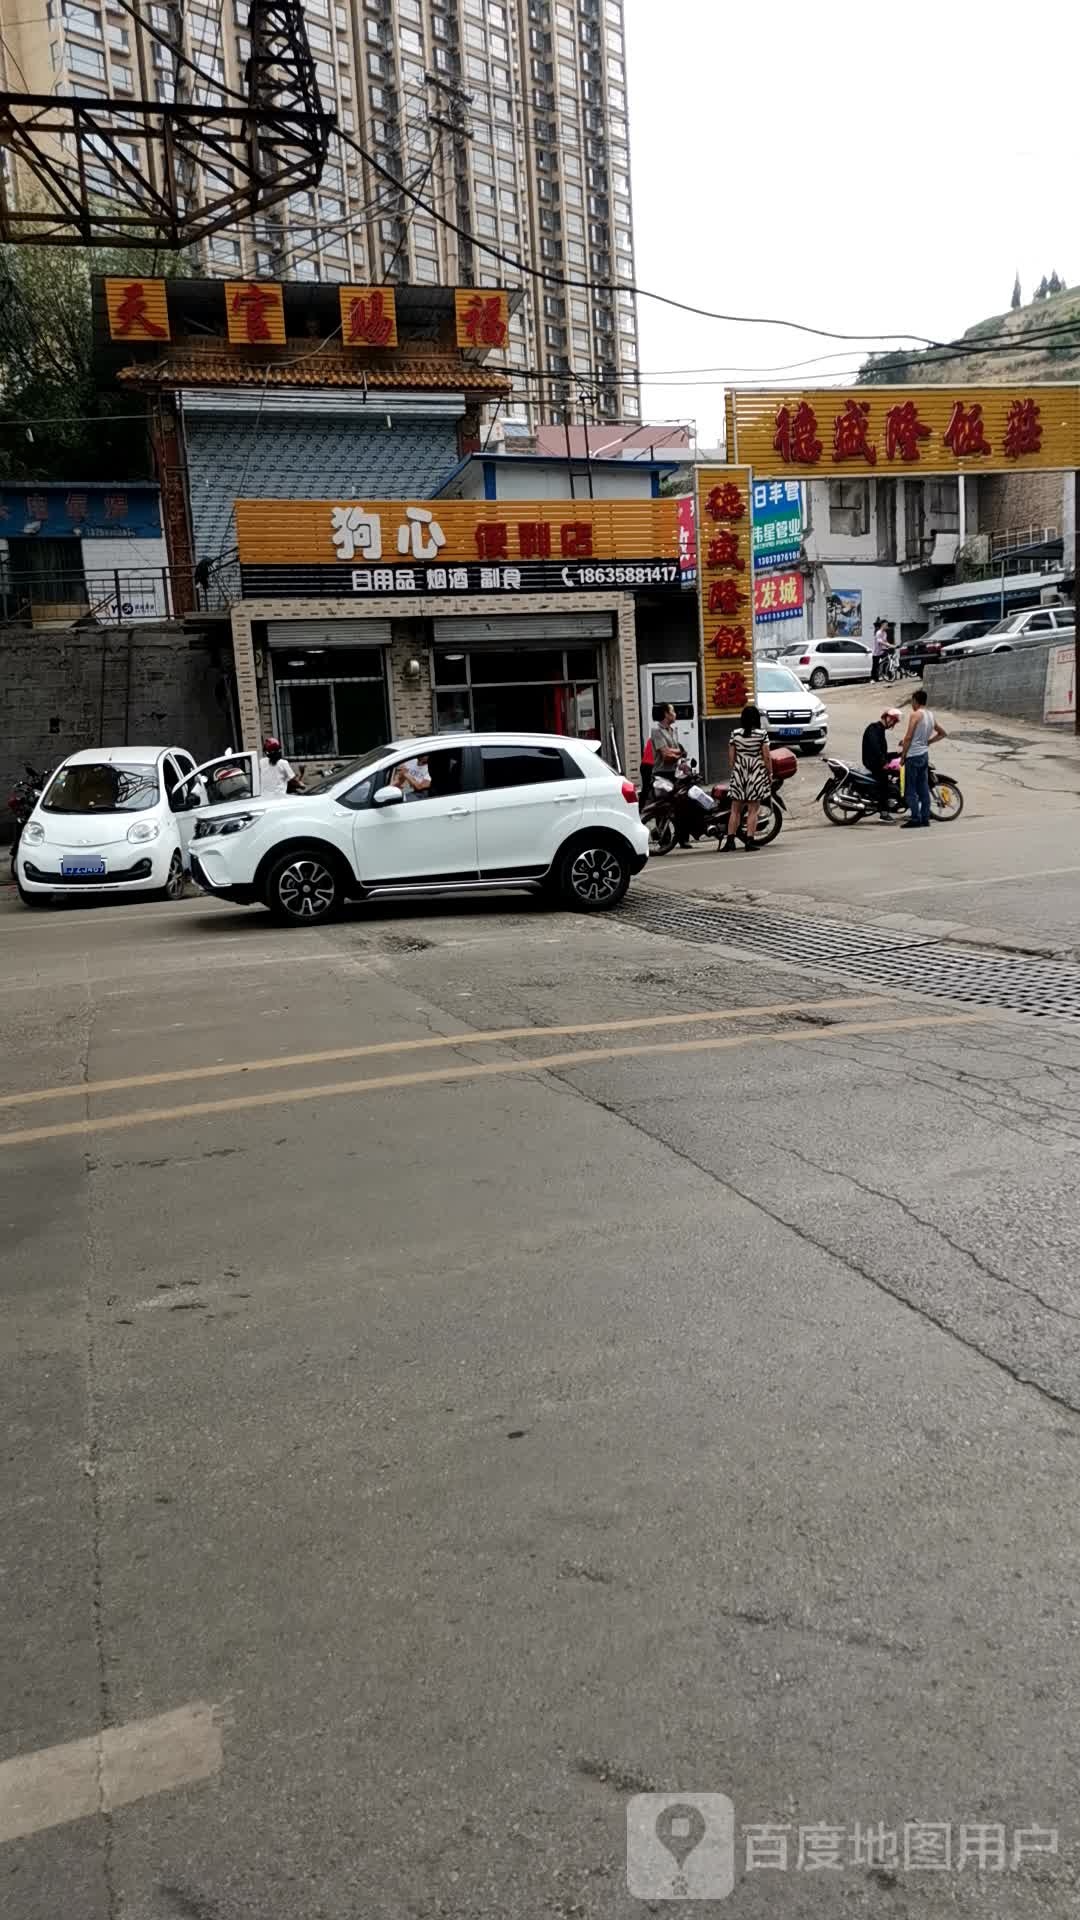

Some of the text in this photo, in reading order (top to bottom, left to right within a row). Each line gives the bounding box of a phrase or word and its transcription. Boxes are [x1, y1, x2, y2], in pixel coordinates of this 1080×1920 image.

[332, 506, 593, 560] 狗心 便利店
[352, 566, 677, 591] 日用品 烟酒 副食 18635881417
